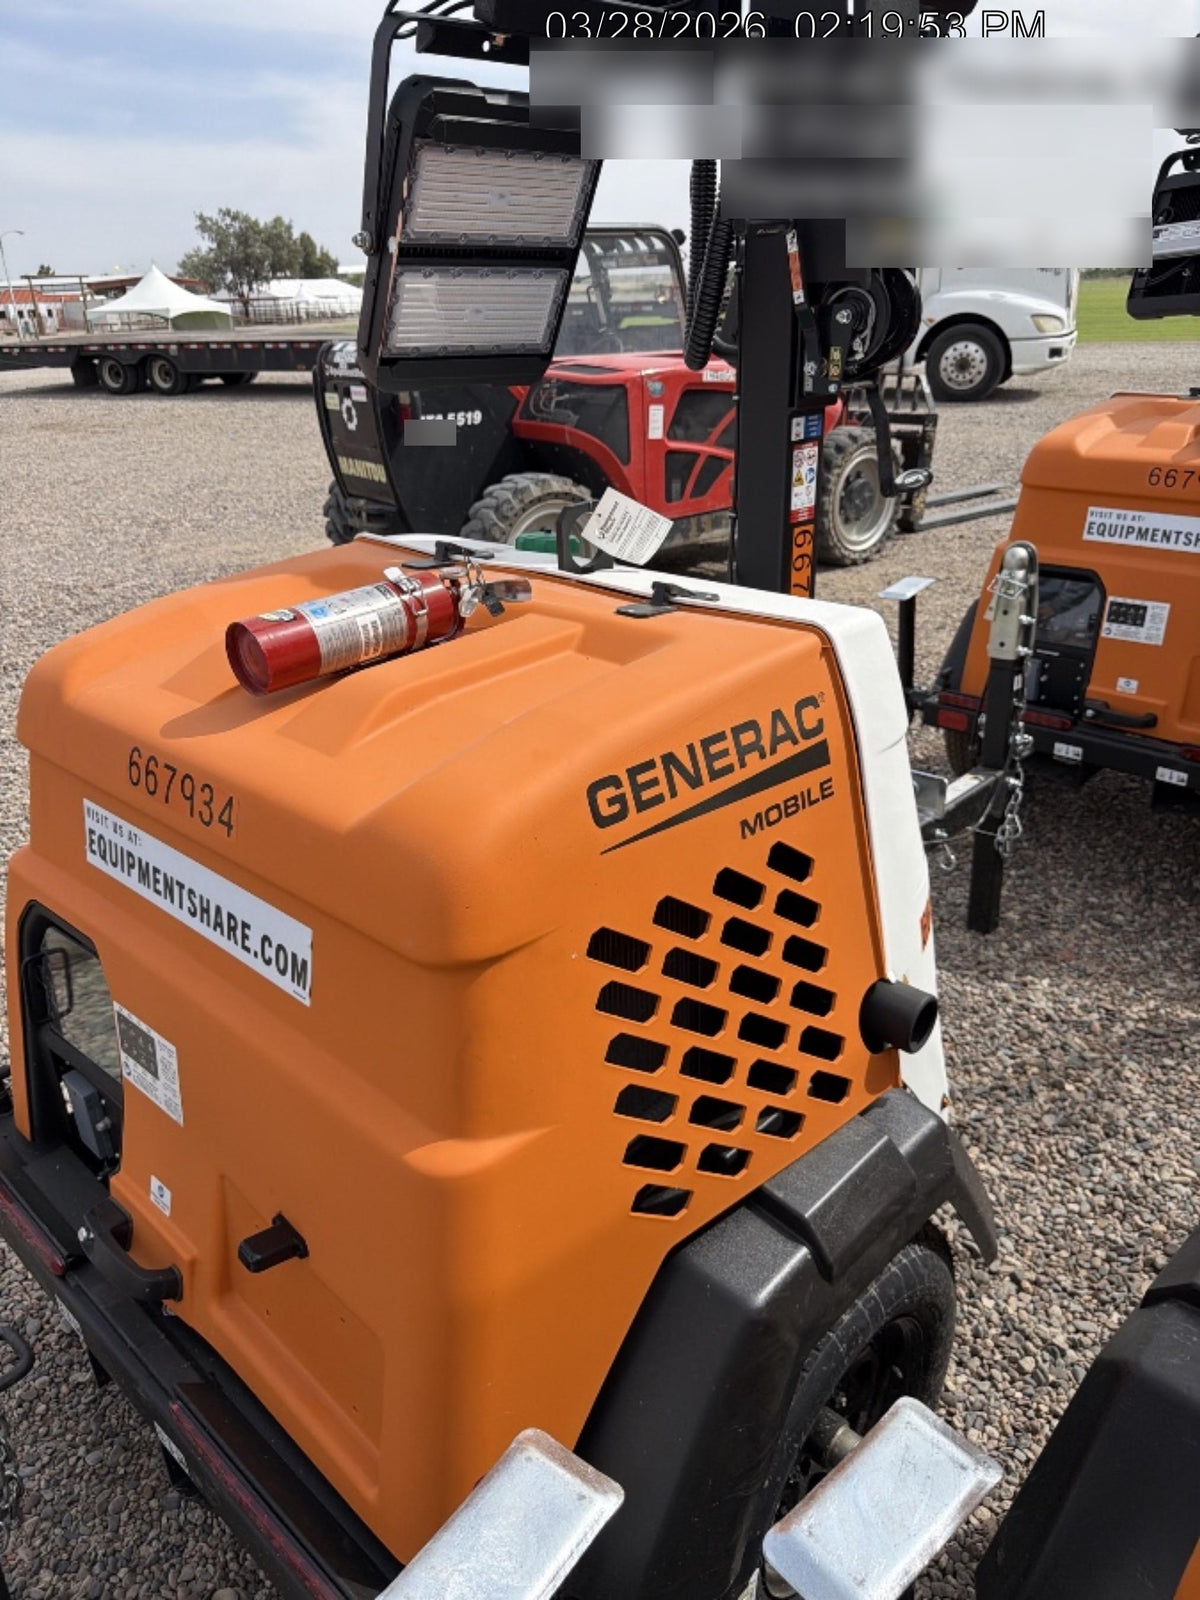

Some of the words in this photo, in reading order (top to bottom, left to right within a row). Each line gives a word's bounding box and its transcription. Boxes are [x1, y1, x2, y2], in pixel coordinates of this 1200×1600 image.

[1147, 466, 1200, 489] 667
[1089, 510, 1114, 518] VISIT
[1116, 512, 1128, 521] US
[793, 530, 813, 592] 667
[128, 746, 234, 838] 667934
[586, 694, 825, 829] GENERAC
[86, 805, 109, 830] VISIT
[112, 821, 124, 838] US
[739, 777, 835, 840] MOBILE
[88, 828, 309, 992] EQUIPMENTSHARE.COM
